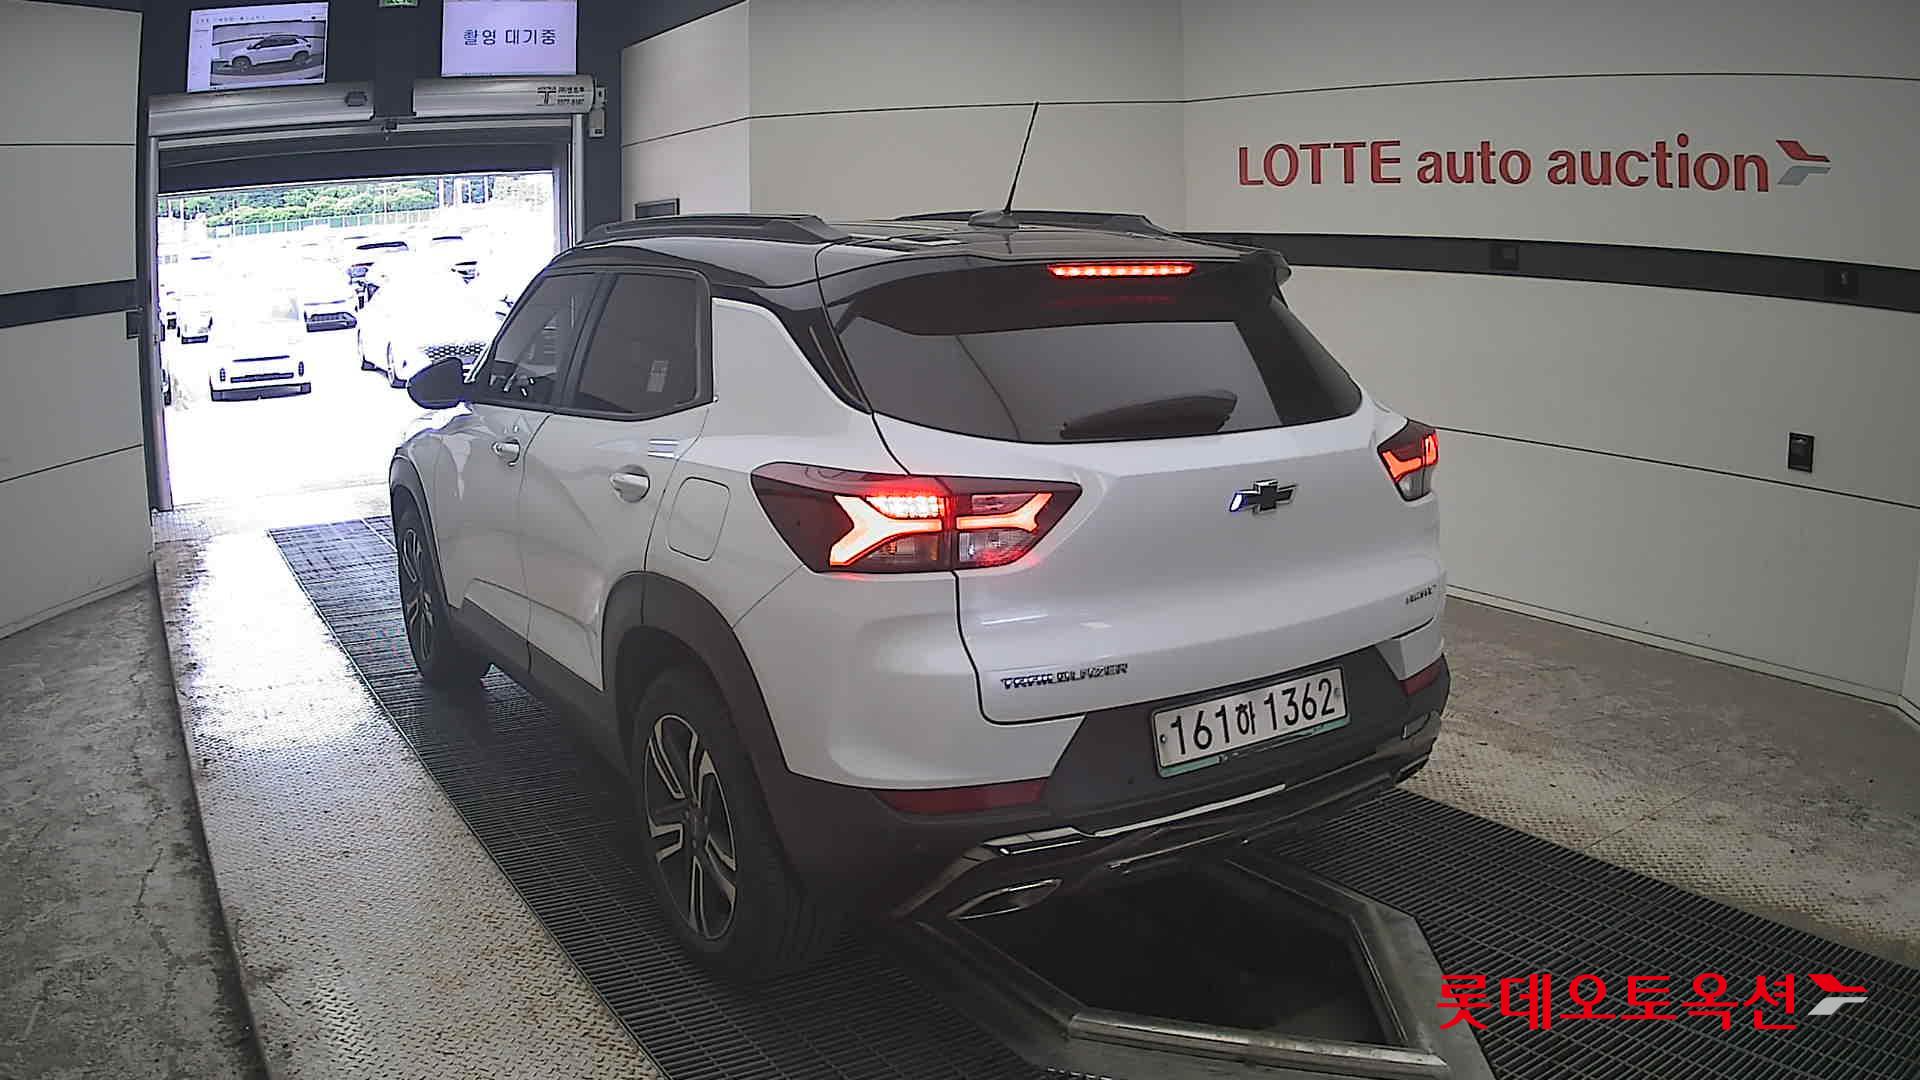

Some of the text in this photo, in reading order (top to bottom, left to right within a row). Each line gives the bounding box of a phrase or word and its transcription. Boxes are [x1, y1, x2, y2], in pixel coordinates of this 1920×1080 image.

[464, 29, 556, 46] 촬영 대기중
[1239, 133, 1769, 192] LOTTE auto auction
[1170, 678, 1335, 755] 161하 1362
